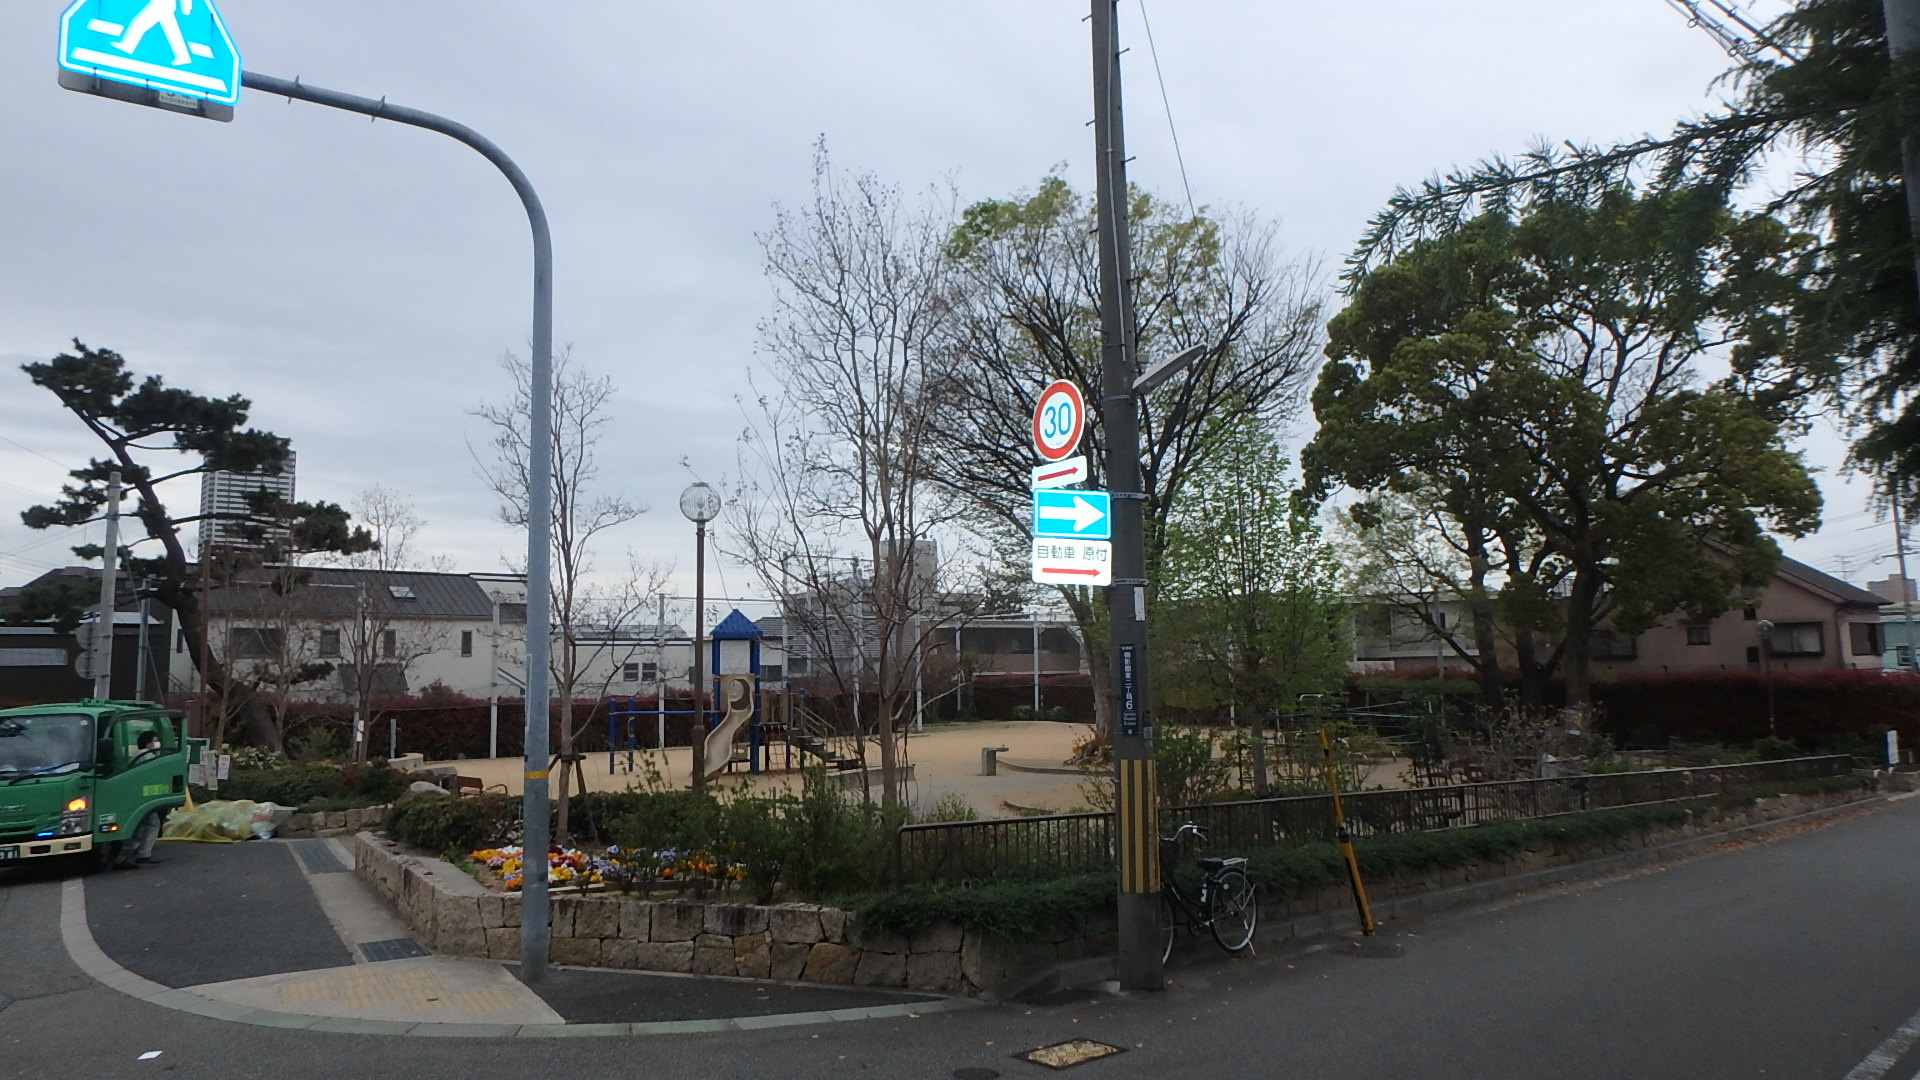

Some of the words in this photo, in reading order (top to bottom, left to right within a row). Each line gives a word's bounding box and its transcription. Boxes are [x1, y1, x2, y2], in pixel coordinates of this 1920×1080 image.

[1044, 402, 1072, 438] 30
[1037, 545, 1076, 560] 自動車
[1082, 547, 1108, 562] 原付
